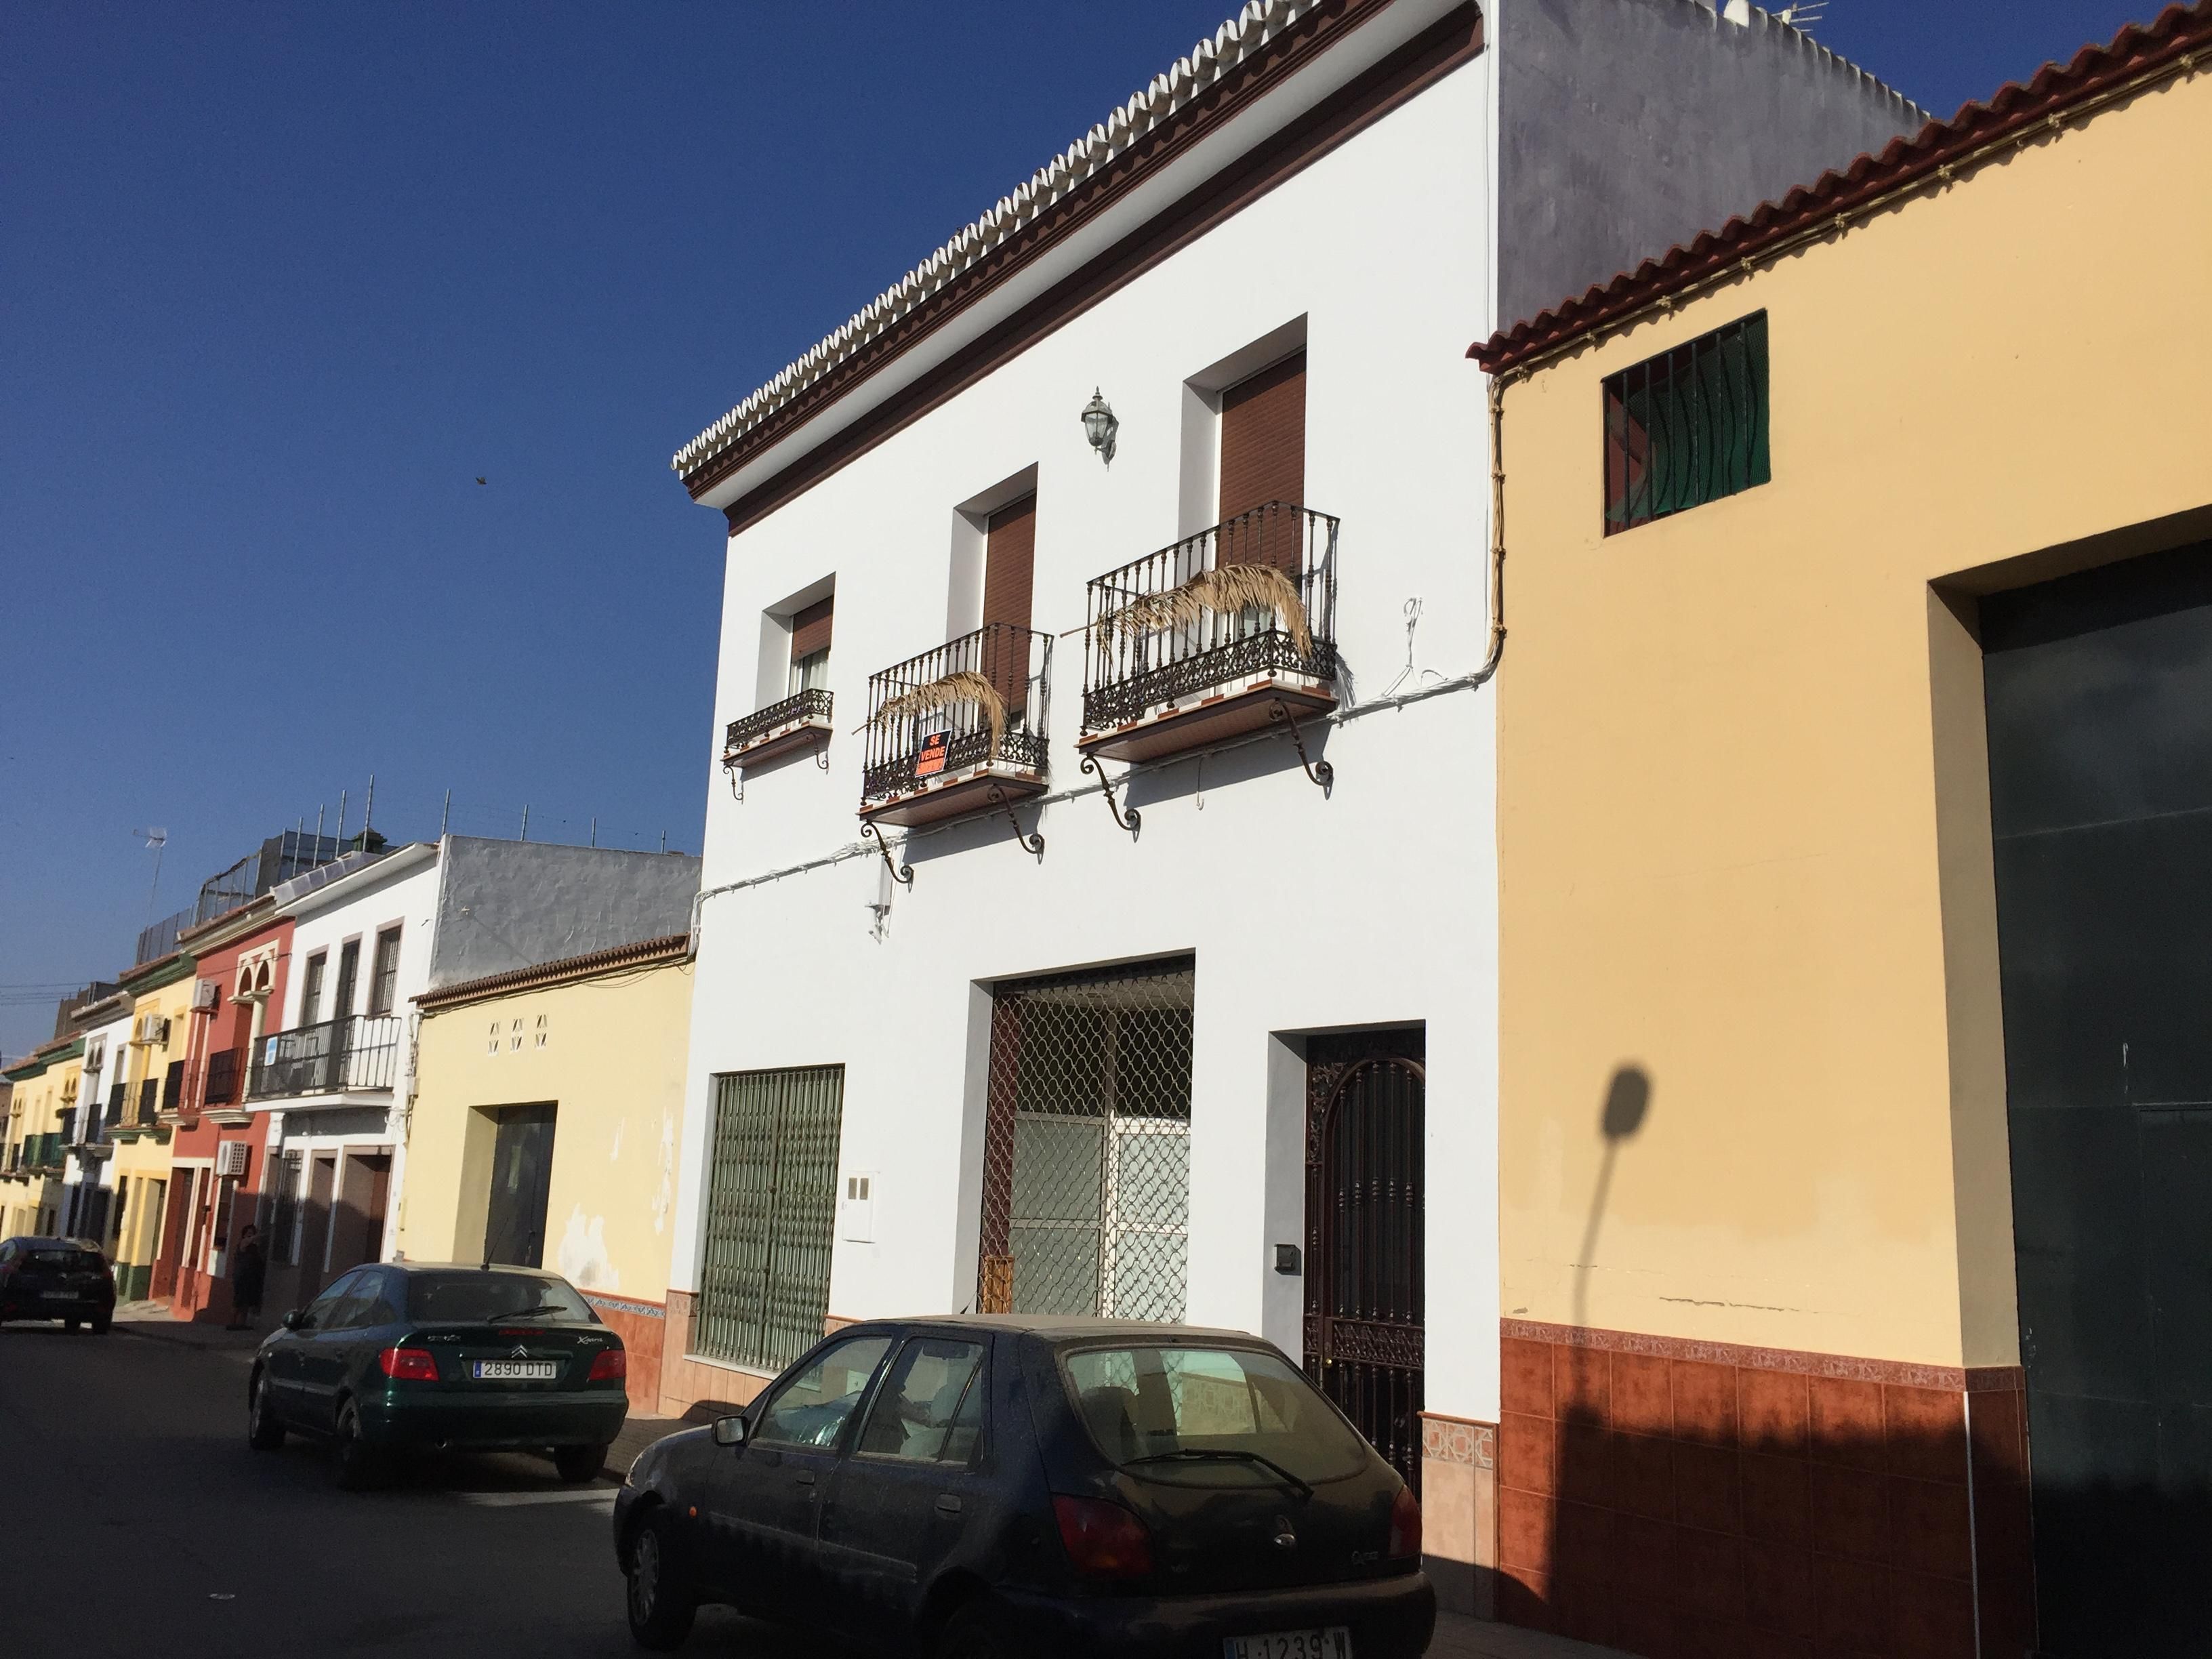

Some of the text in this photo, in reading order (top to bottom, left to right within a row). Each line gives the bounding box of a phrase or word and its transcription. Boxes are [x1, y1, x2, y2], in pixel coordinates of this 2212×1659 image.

[929, 734, 941, 746] SE
[921, 745, 945, 762] VENDE
[485, 1362, 552, 1376] 2890 DTD
